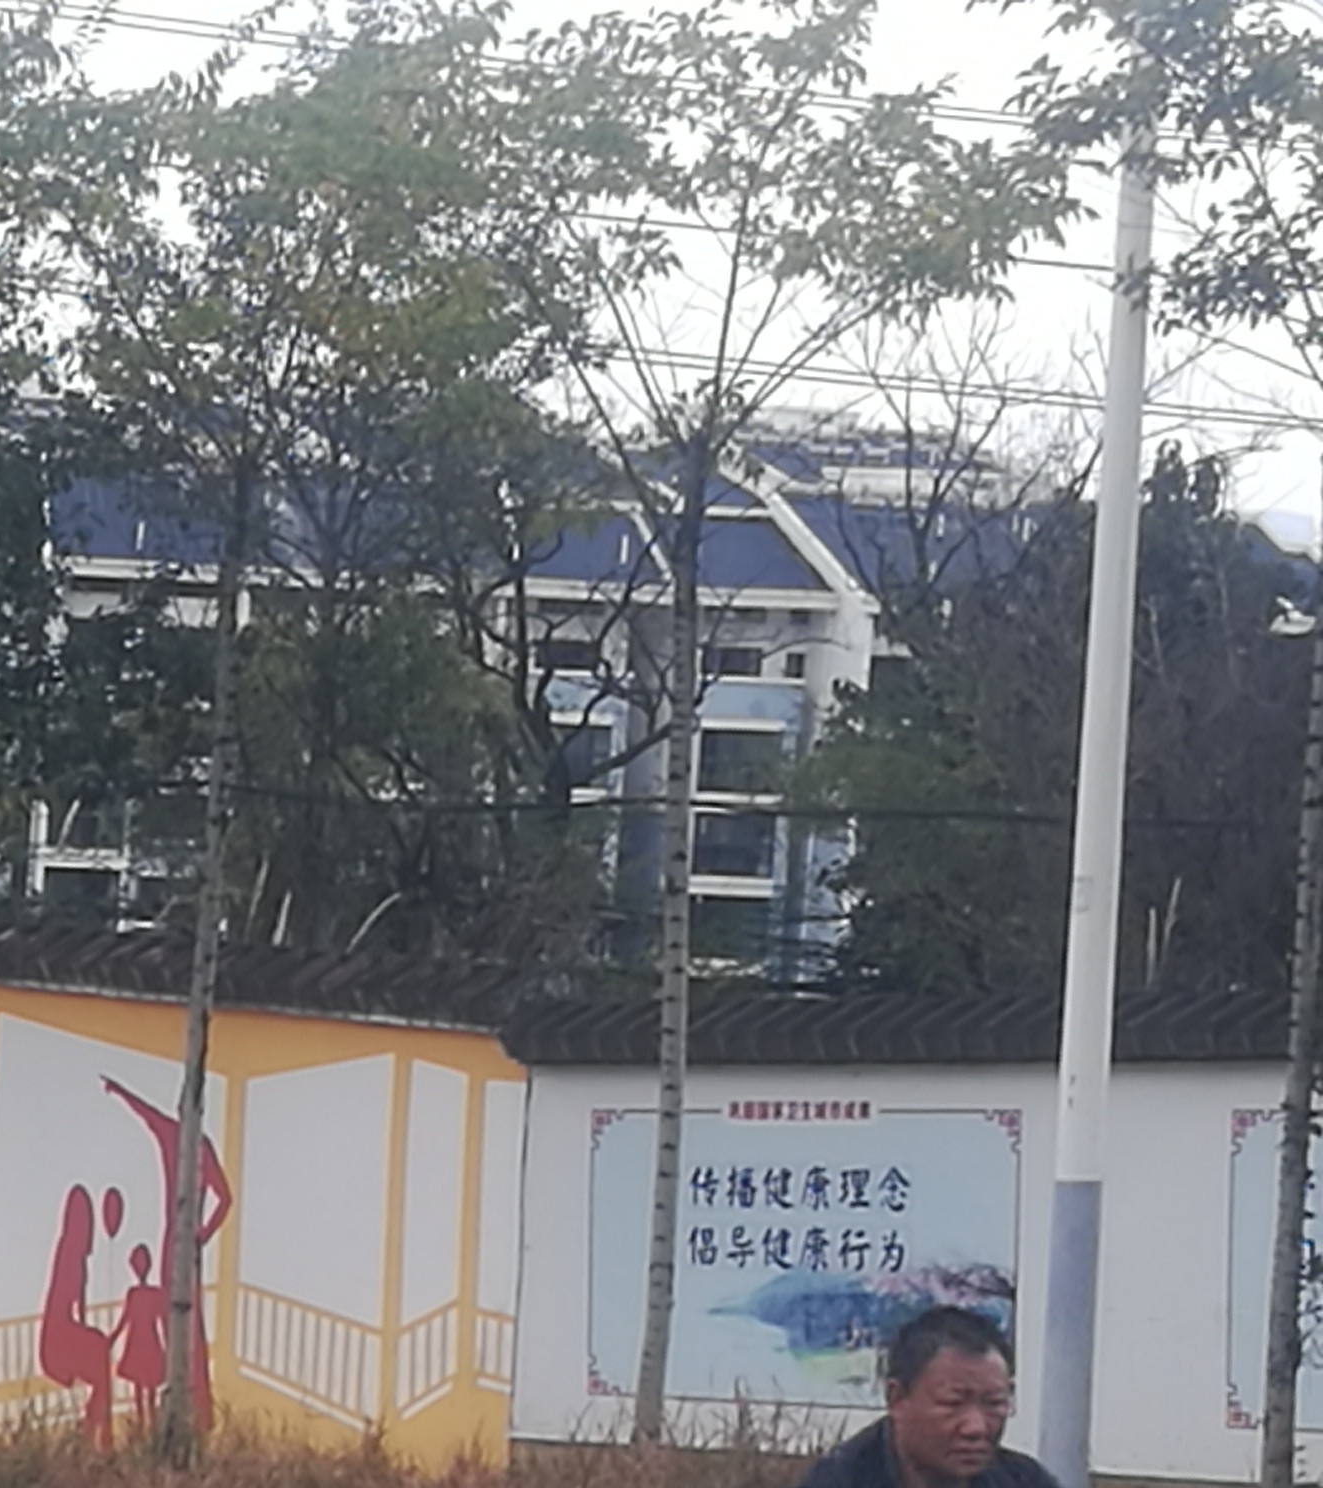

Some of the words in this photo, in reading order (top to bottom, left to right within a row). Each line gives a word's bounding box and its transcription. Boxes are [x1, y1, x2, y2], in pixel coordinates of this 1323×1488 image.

[690, 1166, 911, 1212] 传播健康理念
[689, 1226, 906, 1273] 倡导健康行为
